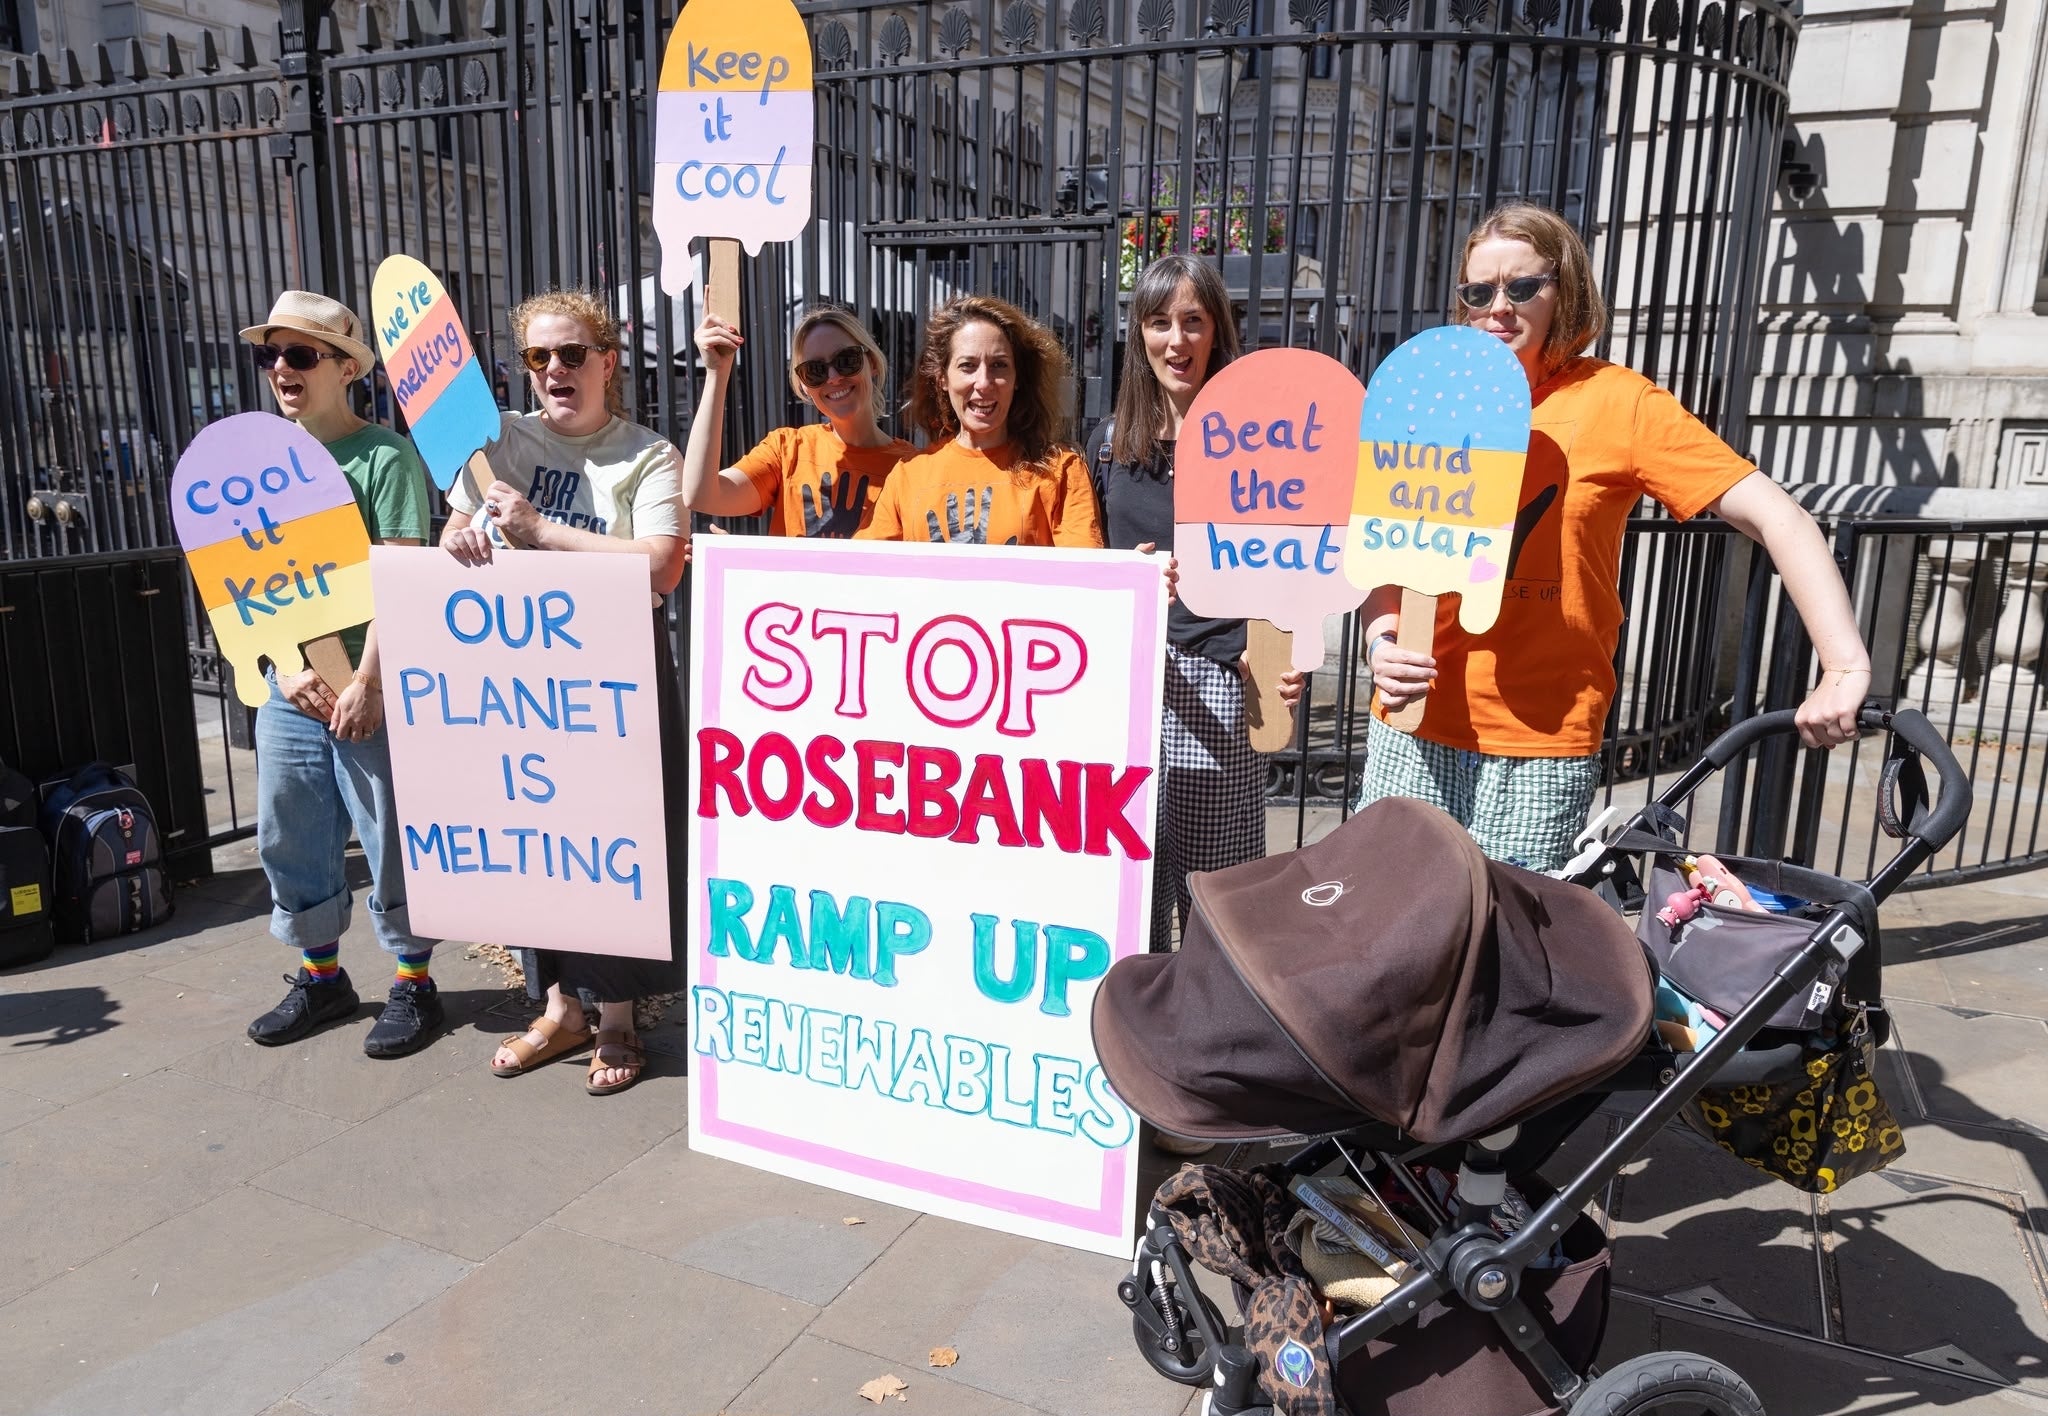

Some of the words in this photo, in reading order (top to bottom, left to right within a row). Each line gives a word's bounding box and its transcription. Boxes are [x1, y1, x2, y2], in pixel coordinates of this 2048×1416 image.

[687, 40, 790, 106] Keep
[699, 96, 732, 144] it
[382, 279, 432, 348] we're
[396, 320, 463, 409] melting
[1201, 401, 1324, 459] Beat
[1373, 430, 1472, 475] wind
[527, 465, 581, 511] FOR
[1230, 468, 1305, 514] the
[1389, 480, 1475, 518] and
[232, 506, 284, 552] it
[1207, 521, 1341, 575] heat
[1363, 515, 1492, 558] solar
[224, 559, 337, 627] Keir
[444, 589, 583, 650] OUR
[742, 601, 1088, 737] STOP
[399, 667, 639, 737] PLANET
[501, 753, 557, 804] IS
[696, 727, 1153, 861] ROSEBANK
[404, 823, 643, 901] MELTING
[707, 877, 933, 988] RAMP
[970, 912, 1111, 1017] UP
[691, 984, 1135, 1149] RENEWABLES
[1300, 1186, 1313, 1201] ALL
[1312, 1197, 1334, 1218] FOURS
[1334, 1214, 1367, 1244] MIRANDA
[1365, 1241, 1386, 1260] JULY
